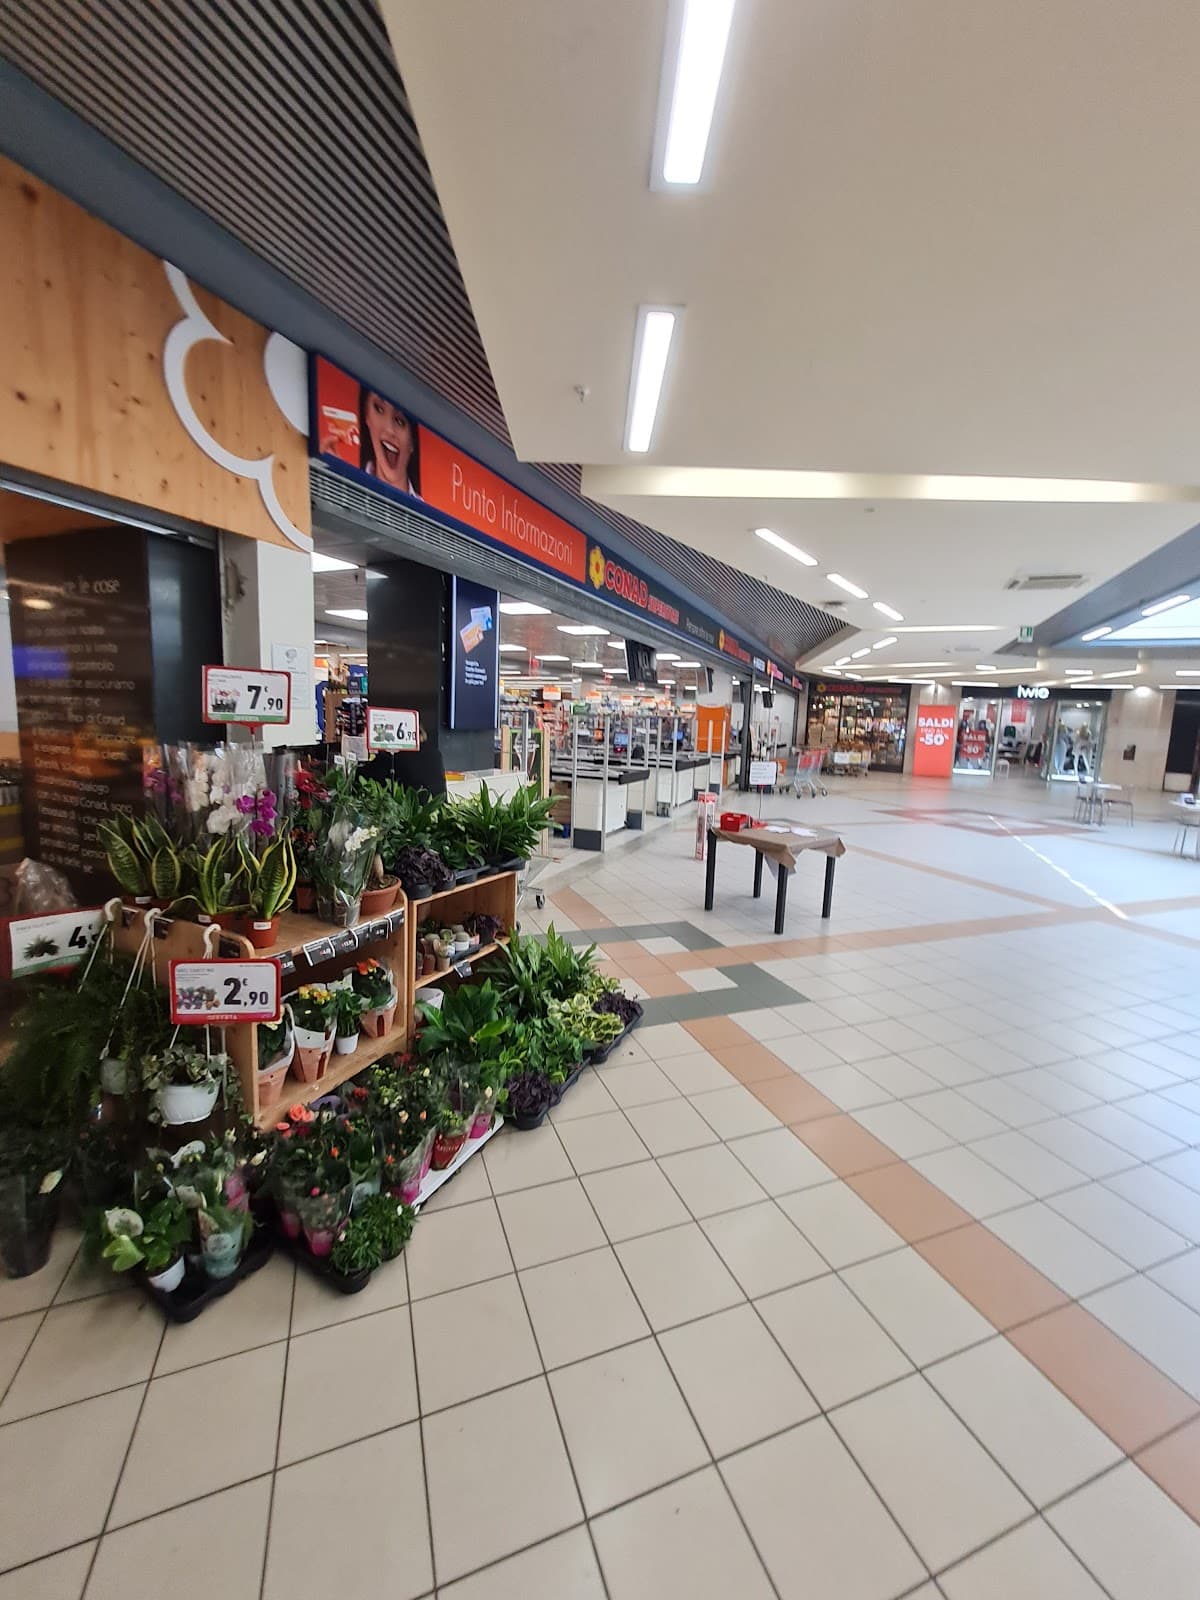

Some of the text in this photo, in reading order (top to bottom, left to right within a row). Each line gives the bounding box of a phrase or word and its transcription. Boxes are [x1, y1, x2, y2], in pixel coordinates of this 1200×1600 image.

[451, 462, 573, 565] Punto Informazioni
[604, 560, 649, 608] CONAD
[918, 717, 954, 729] SALDI
